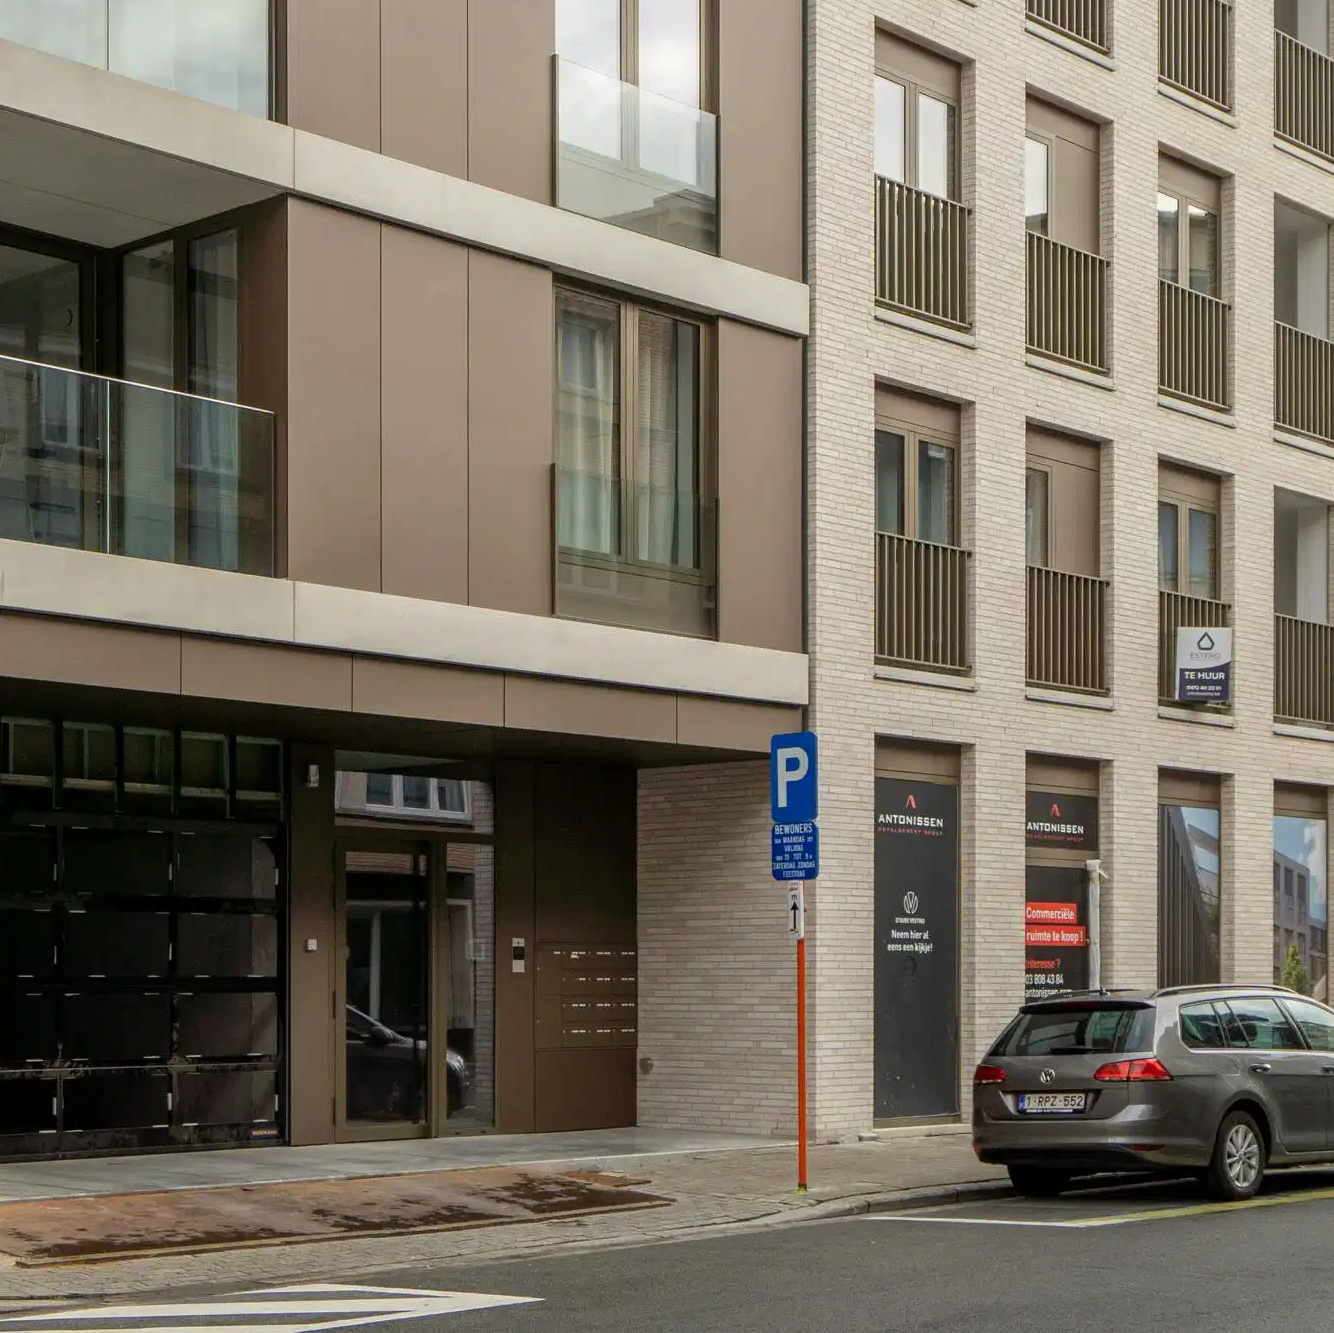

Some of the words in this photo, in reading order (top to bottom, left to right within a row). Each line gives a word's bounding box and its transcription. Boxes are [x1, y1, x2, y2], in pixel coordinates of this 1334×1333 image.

[1184, 671, 1196, 679] TE
[1198, 672, 1225, 680] HUUR
[777, 747, 809, 808] P
[878, 814, 944, 828] ANTONISSEN
[774, 823, 813, 834] BEWONERS
[1027, 821, 1084, 834] ANTONISSEN
[1026, 907, 1075, 919] Commerciële
[891, 929, 909, 939] Neem
[910, 930, 922, 939] hier
[922, 930, 929, 939] al
[1026, 930, 1051, 942] ruimte
[1052, 930, 1060, 942] te
[1061, 930, 1079, 945] koop
[887, 943, 902, 951] eens
[914, 943, 933, 954] kijkje!
[1026, 959, 1055, 969] nteresse
[1025, 974, 1033, 985] 03
[1046, 974, 1055, 985] 43
[1056, 974, 1064, 985] 84
[1027, 1096, 1084, 1107] 1-RPZ-552
